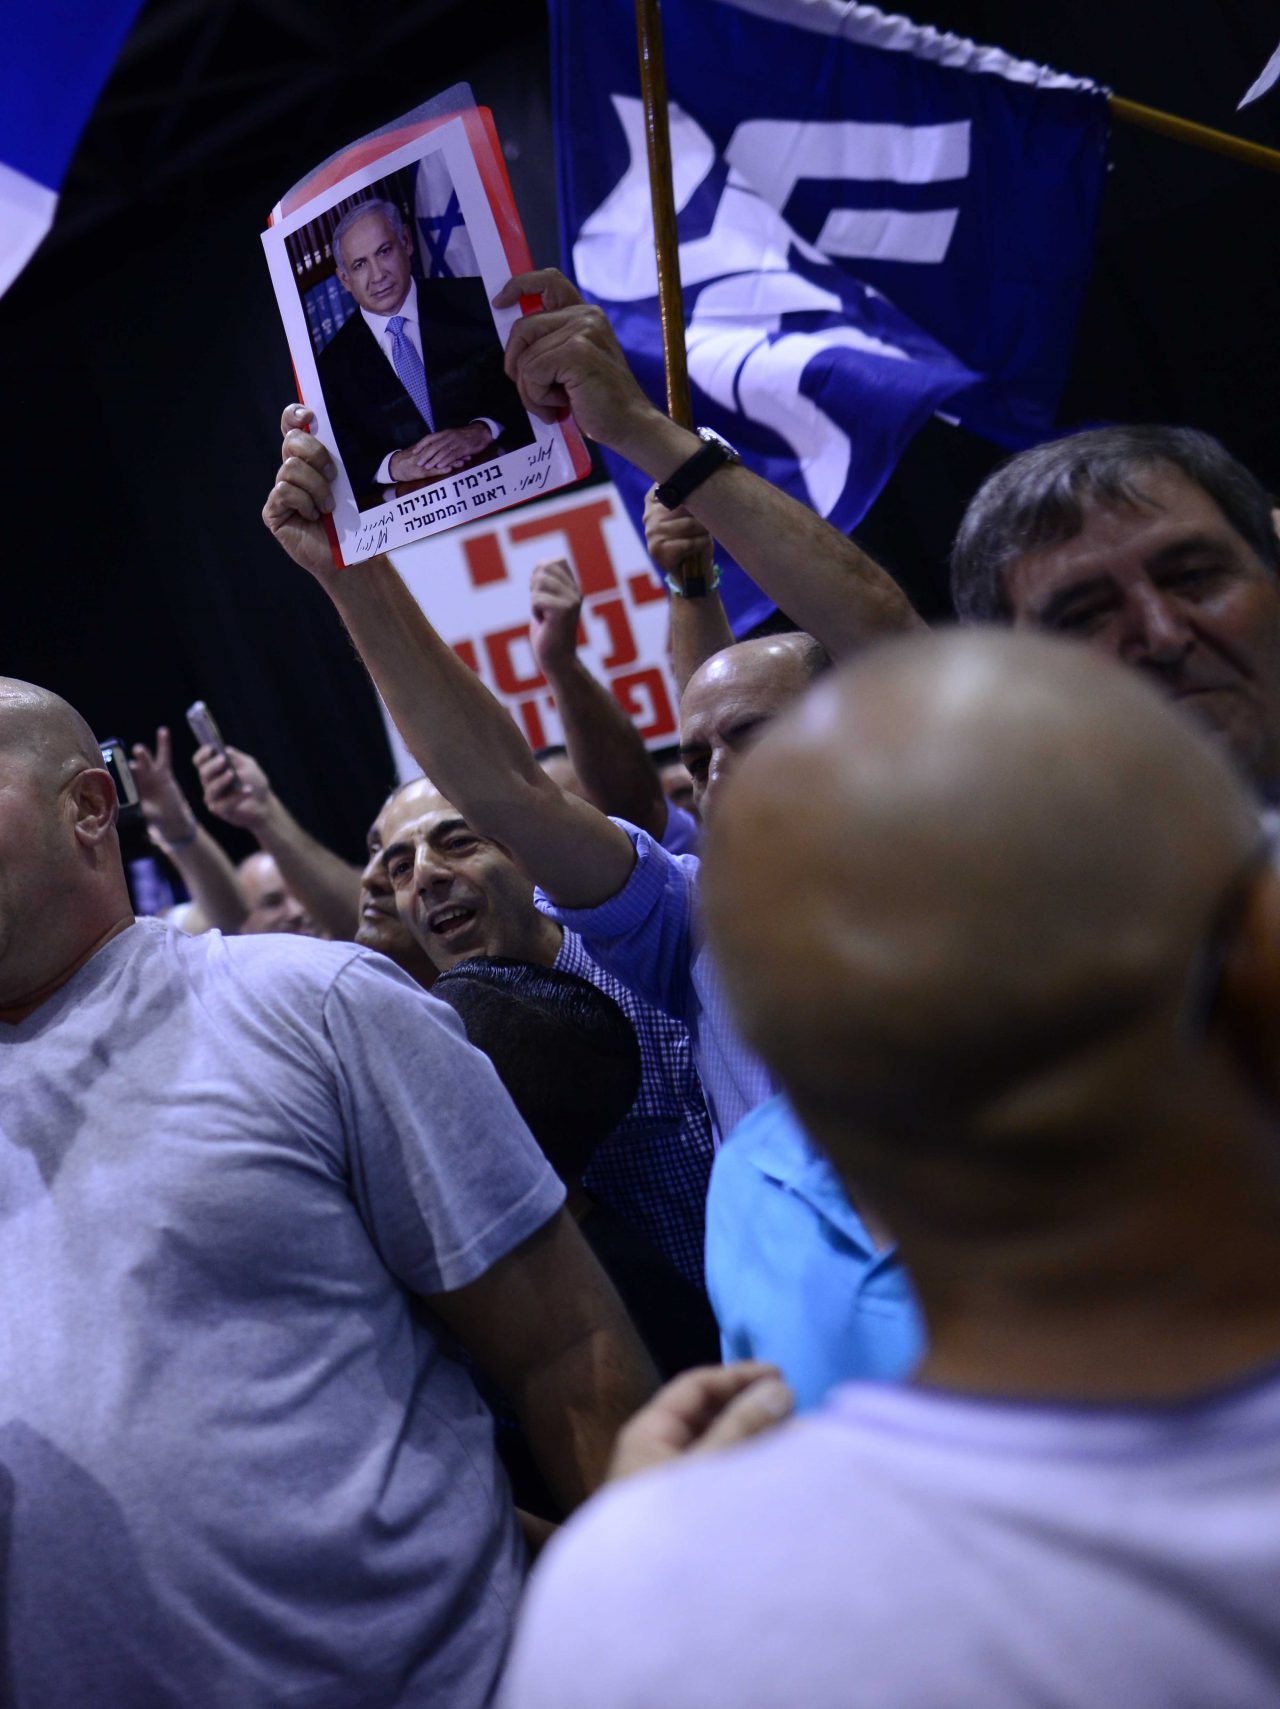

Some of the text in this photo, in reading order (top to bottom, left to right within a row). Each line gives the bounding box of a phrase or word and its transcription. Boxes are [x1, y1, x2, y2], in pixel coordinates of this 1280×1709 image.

[396, 464, 503, 516] בנימין נתניהו
[472, 484, 506, 506] ראש
[404, 500, 468, 533] הממשלה
[462, 499, 617, 596] די
